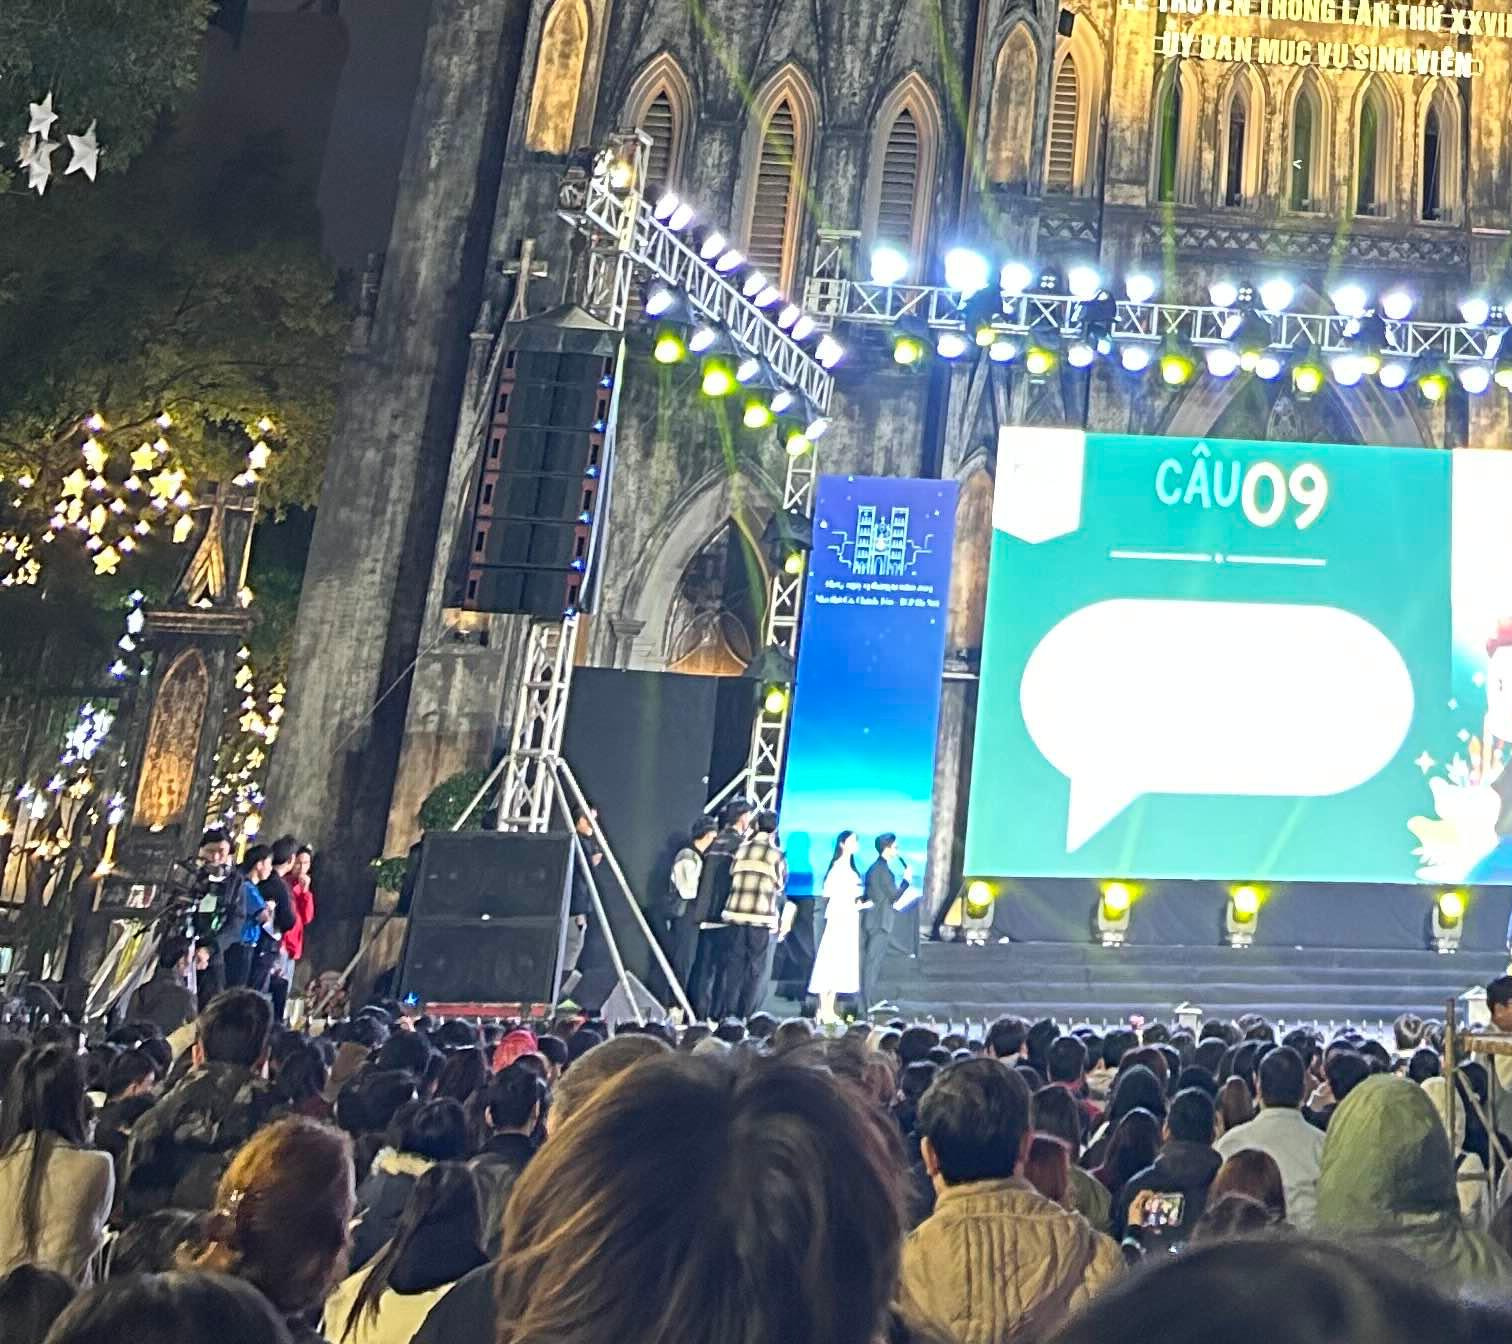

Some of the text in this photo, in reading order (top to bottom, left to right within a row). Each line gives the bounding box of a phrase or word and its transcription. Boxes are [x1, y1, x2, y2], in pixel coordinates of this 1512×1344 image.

[1396, 0, 1444, 33] THỨ
[1200, 33, 1252, 63] BAN
[1353, 43, 1411, 73] SINH
[1416, 45, 1473, 78] VIÊN
[1155, 441, 1328, 530] CÂU 09
